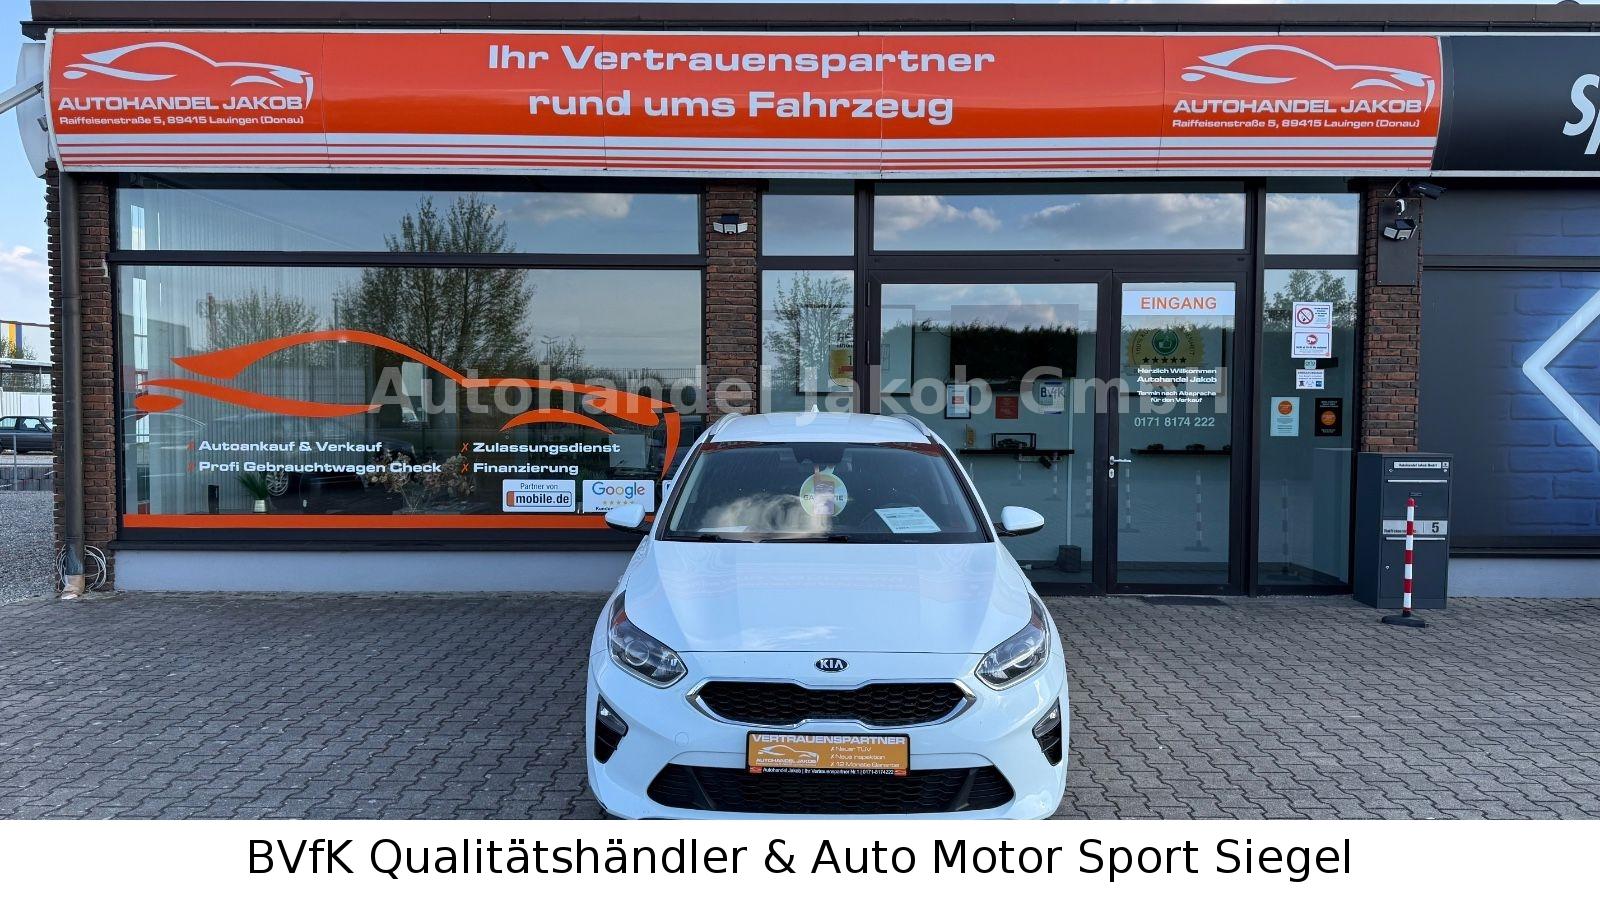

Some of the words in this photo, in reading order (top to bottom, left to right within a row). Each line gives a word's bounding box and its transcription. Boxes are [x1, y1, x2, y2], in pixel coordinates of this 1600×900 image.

[488, 44, 549, 70] Ihr
[561, 45, 995, 78] Vertrauenspartner
[57, 96, 219, 111] AUTOHANDEL
[222, 96, 303, 111] JAKOB
[529, 90, 631, 116] rund
[644, 96, 736, 118] ums
[748, 91, 954, 126] Fahrzeug
[1172, 99, 1337, 114] AUTOHANDEL
[1340, 99, 1422, 114] JAKOB
[59, 115, 152, 125] Raiffeisenstraße
[153, 116, 166, 126] 5,
[167, 116, 207, 125] 89415
[208, 116, 259, 126] Lauingen
[260, 116, 304, 126] (Donau)
[1172, 119, 1266, 128] Raiffeisenstraße
[1267, 119, 1279, 129] 5,
[1281, 119, 1323, 128] 89415
[1324, 119, 1374, 129] Lauingen
[1376, 119, 1420, 128] (Donau)
[1140, 296, 1217, 310] EINGANG
[1134, 416, 1160, 427] 0171
[1164, 416, 1191, 427] 8174
[1194, 416, 1216, 427] 222
[198, 440, 295, 452] Autoankauf
[298, 440, 312, 452] &
[316, 440, 383, 452] Verkauf
[472, 442, 621, 455] Zulassungsdienst
[199, 461, 240, 472] Profi
[243, 461, 386, 476] Gebrauchtwagen
[389, 461, 442, 473] Check
[473, 462, 579, 476] Finanzierung
[520, 482, 544, 490] Partner
[592, 481, 646, 499] Google
[515, 493, 570, 504] mobile.de
[1431, 521, 1440, 534] 5
[820, 659, 844, 669] KIA
[751, 733, 906, 745] VERTRAUENSPARTNER
